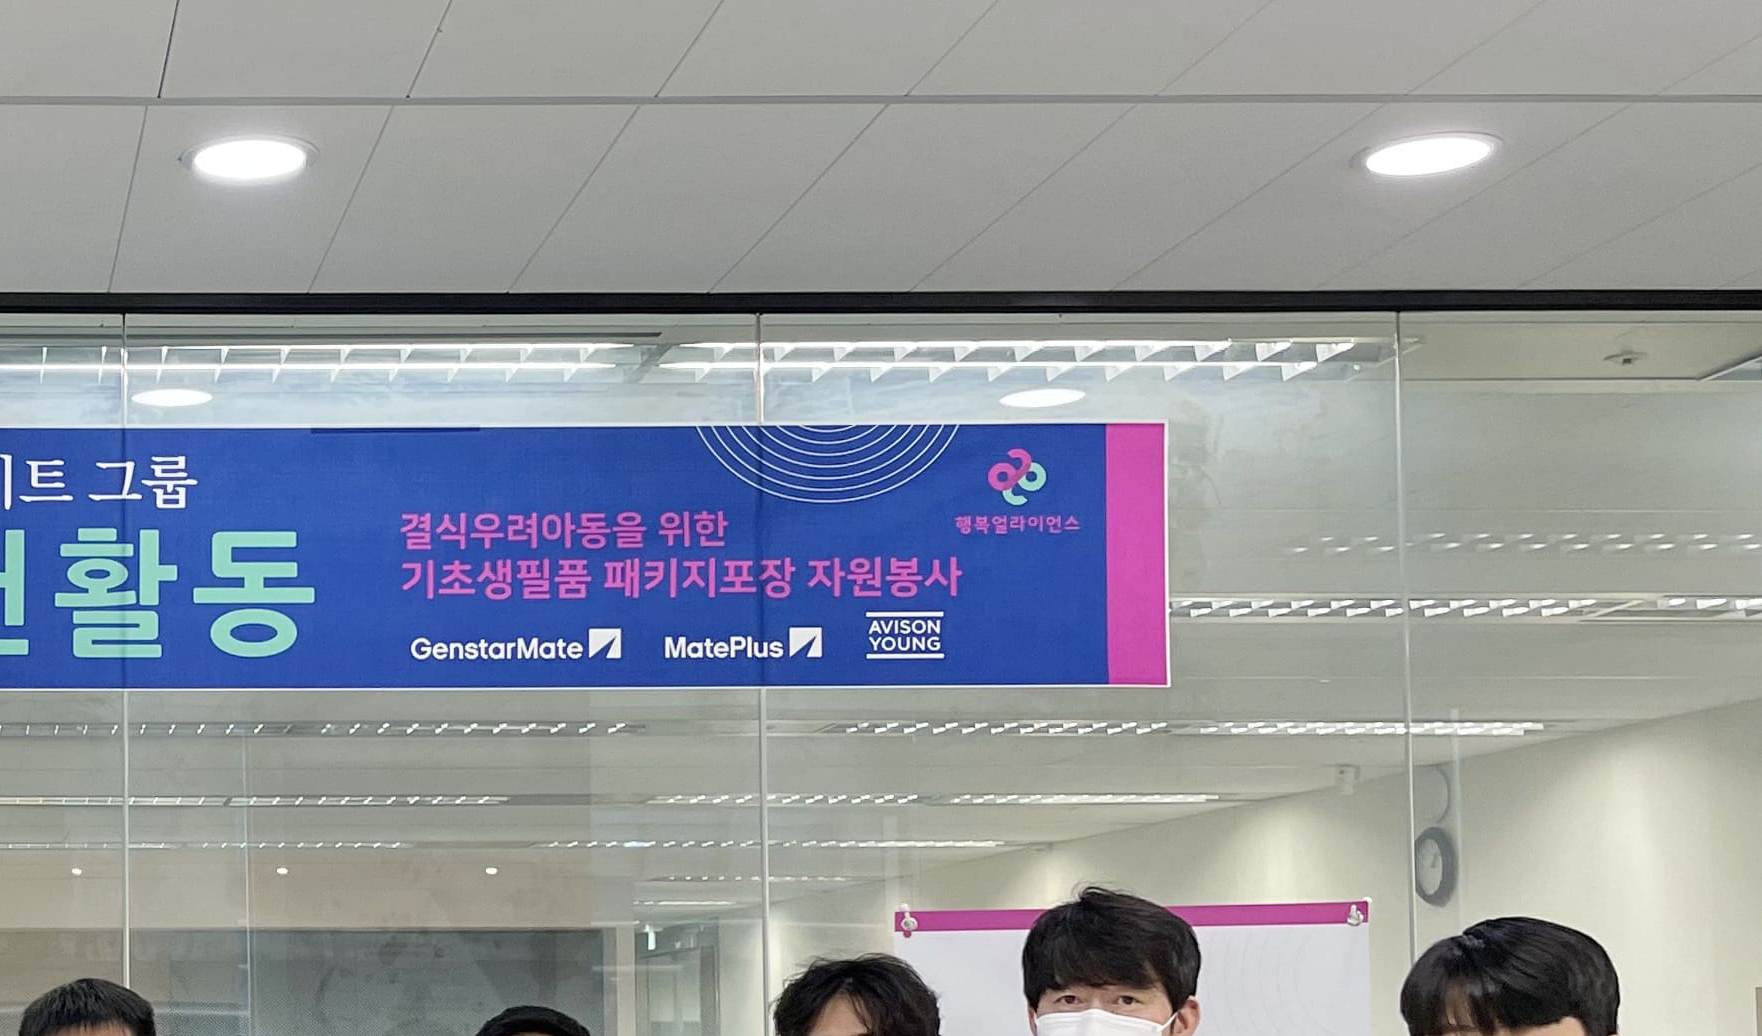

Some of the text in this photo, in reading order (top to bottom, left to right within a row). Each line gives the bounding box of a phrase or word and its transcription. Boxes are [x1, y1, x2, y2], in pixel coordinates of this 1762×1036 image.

[87, 454, 199, 510] 그룹
[399, 511, 729, 550] 결식우려아동을 위한
[954, 514, 1081, 535] 행복얼라이언스
[401, 556, 964, 601] 기초생필품 패키지포장 자원봉사
[867, 618, 942, 636] AVISON
[409, 636, 584, 662] GenstarMate
[663, 635, 785, 661] MatePlus
[867, 635, 942, 653] YOUNG
